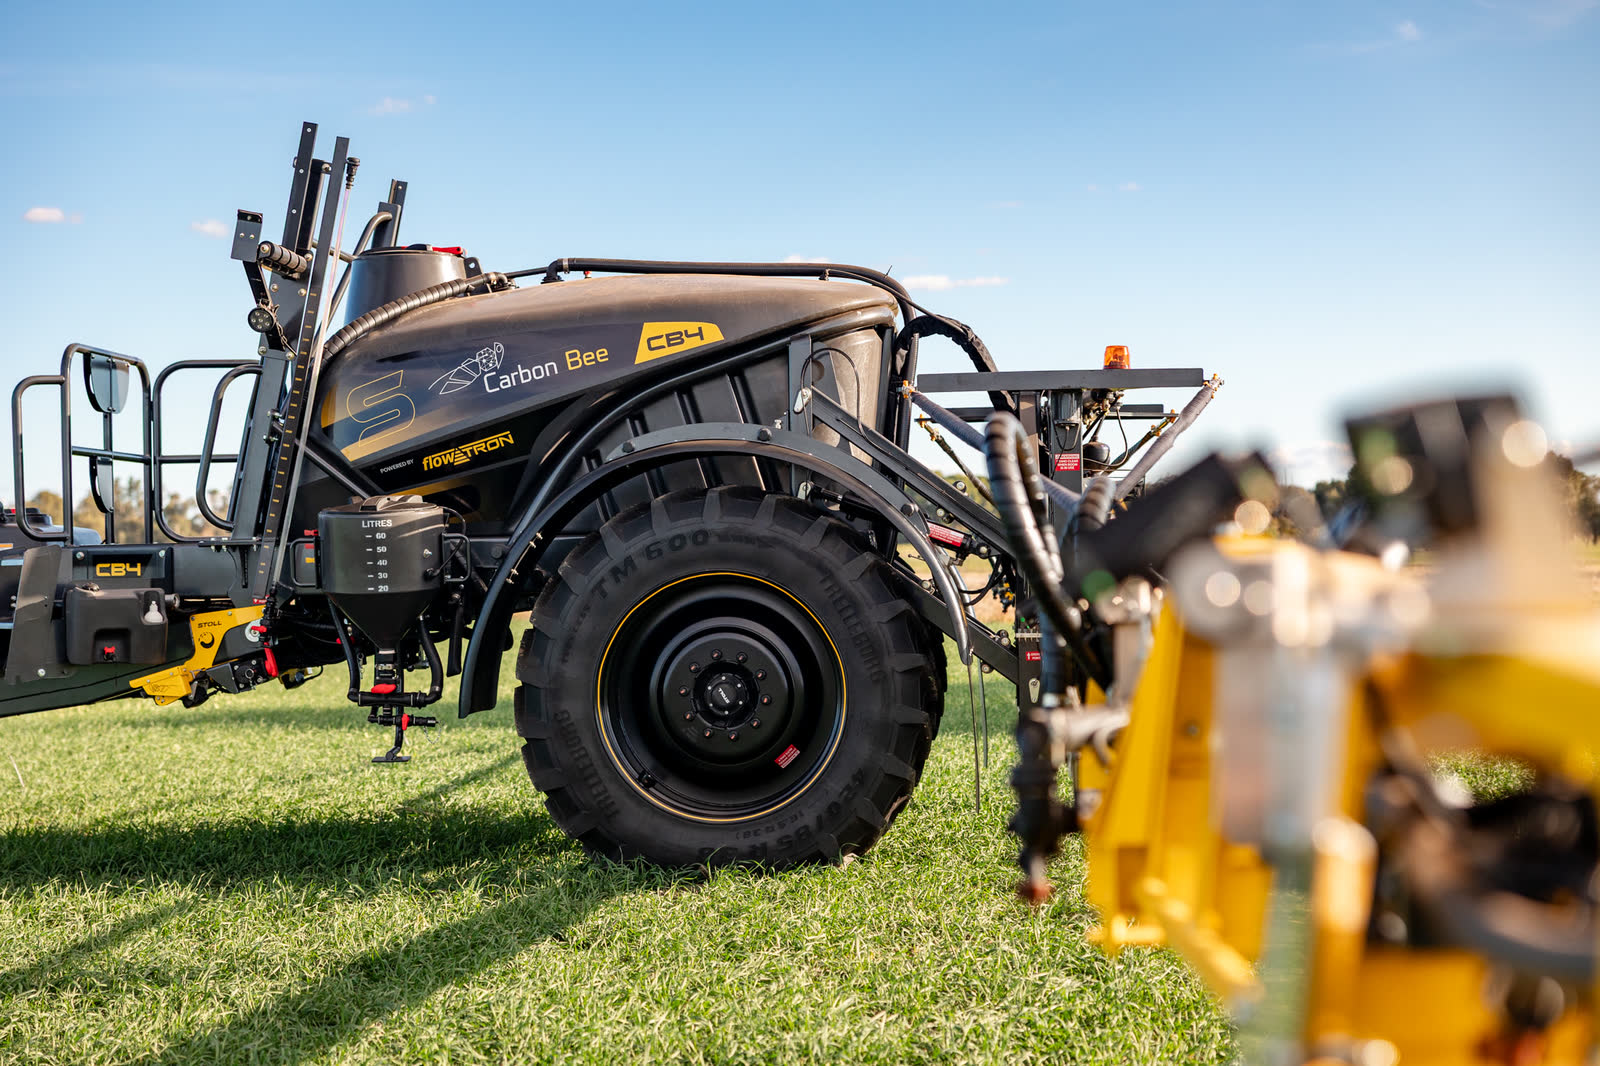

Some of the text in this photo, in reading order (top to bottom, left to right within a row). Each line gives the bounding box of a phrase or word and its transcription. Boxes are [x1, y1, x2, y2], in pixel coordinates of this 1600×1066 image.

[646, 326, 705, 352] CB4
[483, 345, 609, 394] Carbon Bee
[379, 458, 415, 474] POWERED BY
[362, 519, 393, 528] LITRES
[95, 562, 142, 577] CB4
[591, 553, 638, 599] TM
[645, 529, 710, 560] 600
[197, 620, 223, 629] STOLL
